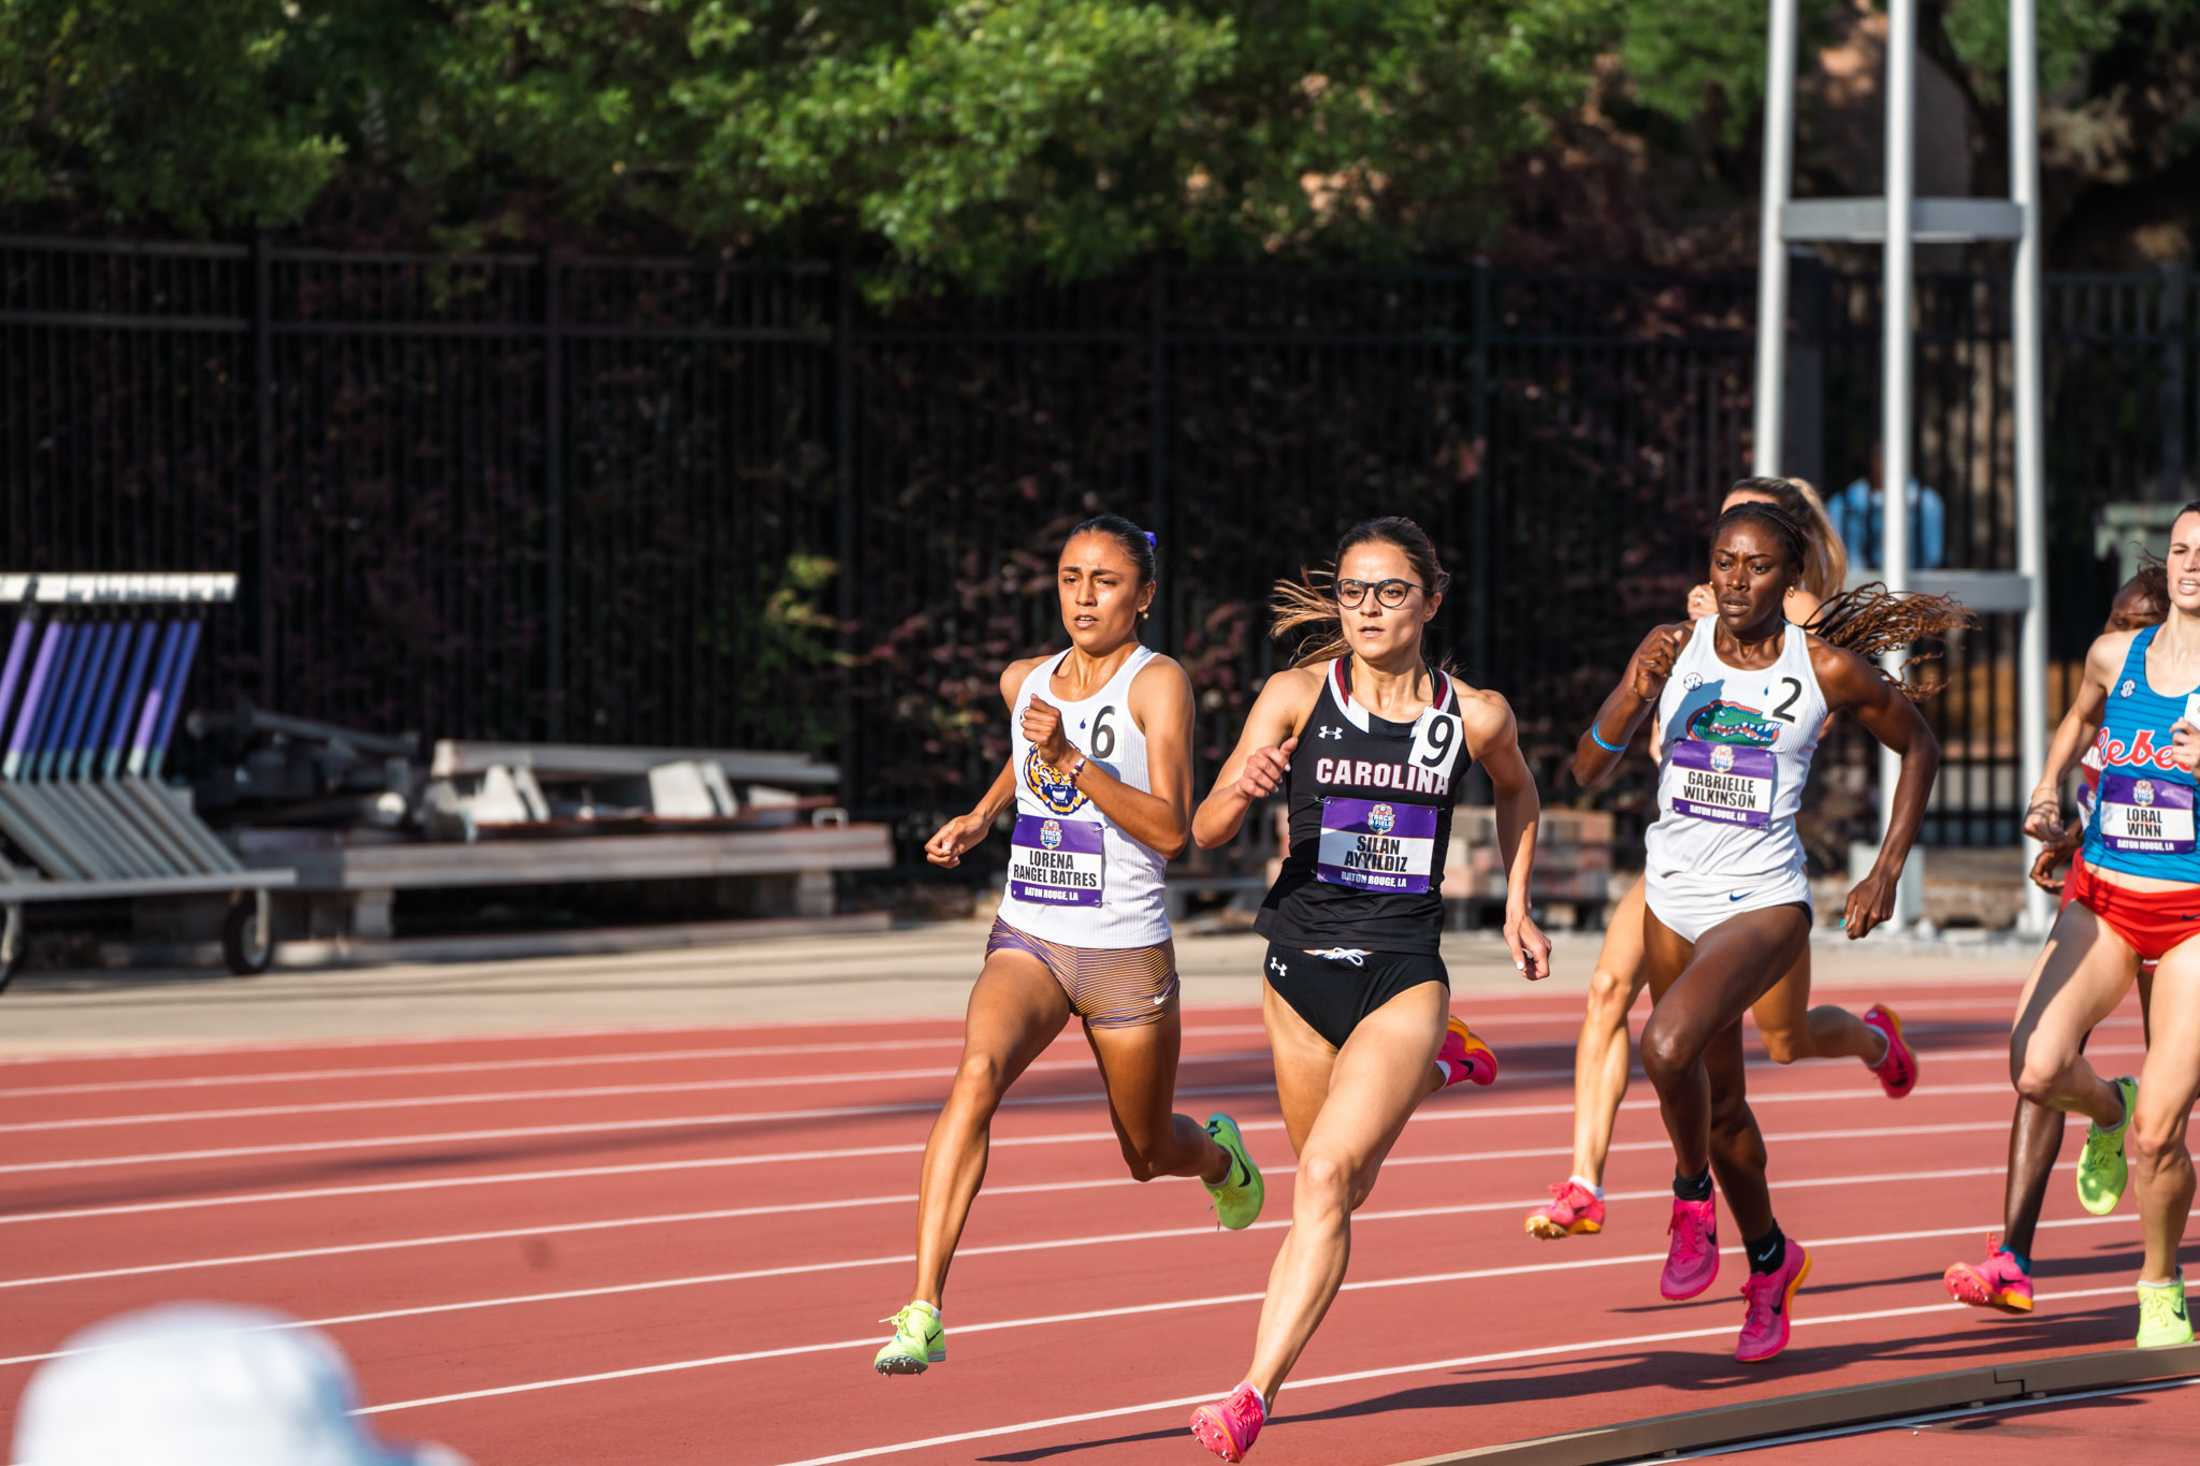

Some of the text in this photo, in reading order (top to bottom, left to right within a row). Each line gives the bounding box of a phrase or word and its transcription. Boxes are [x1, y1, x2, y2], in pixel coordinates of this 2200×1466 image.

[1772, 677, 1802, 723] 2
[1091, 705, 1116, 759] 6
[1420, 714, 1455, 769] 9
[1316, 758, 1449, 796] CAROLINA
[1688, 771, 1755, 794] GABRIELLE
[1683, 785, 1756, 809] WILKINSON
[2126, 807, 2163, 824] LORAL
[2127, 822, 2162, 838] WINN
[1357, 836, 1400, 855] SILAN
[1029, 850, 1074, 870] LORENA
[1344, 850, 1408, 873] AYYILDIZ
[1013, 863, 1097, 888] RANGEL BATRES
[1397, 876, 1407, 888] LA
